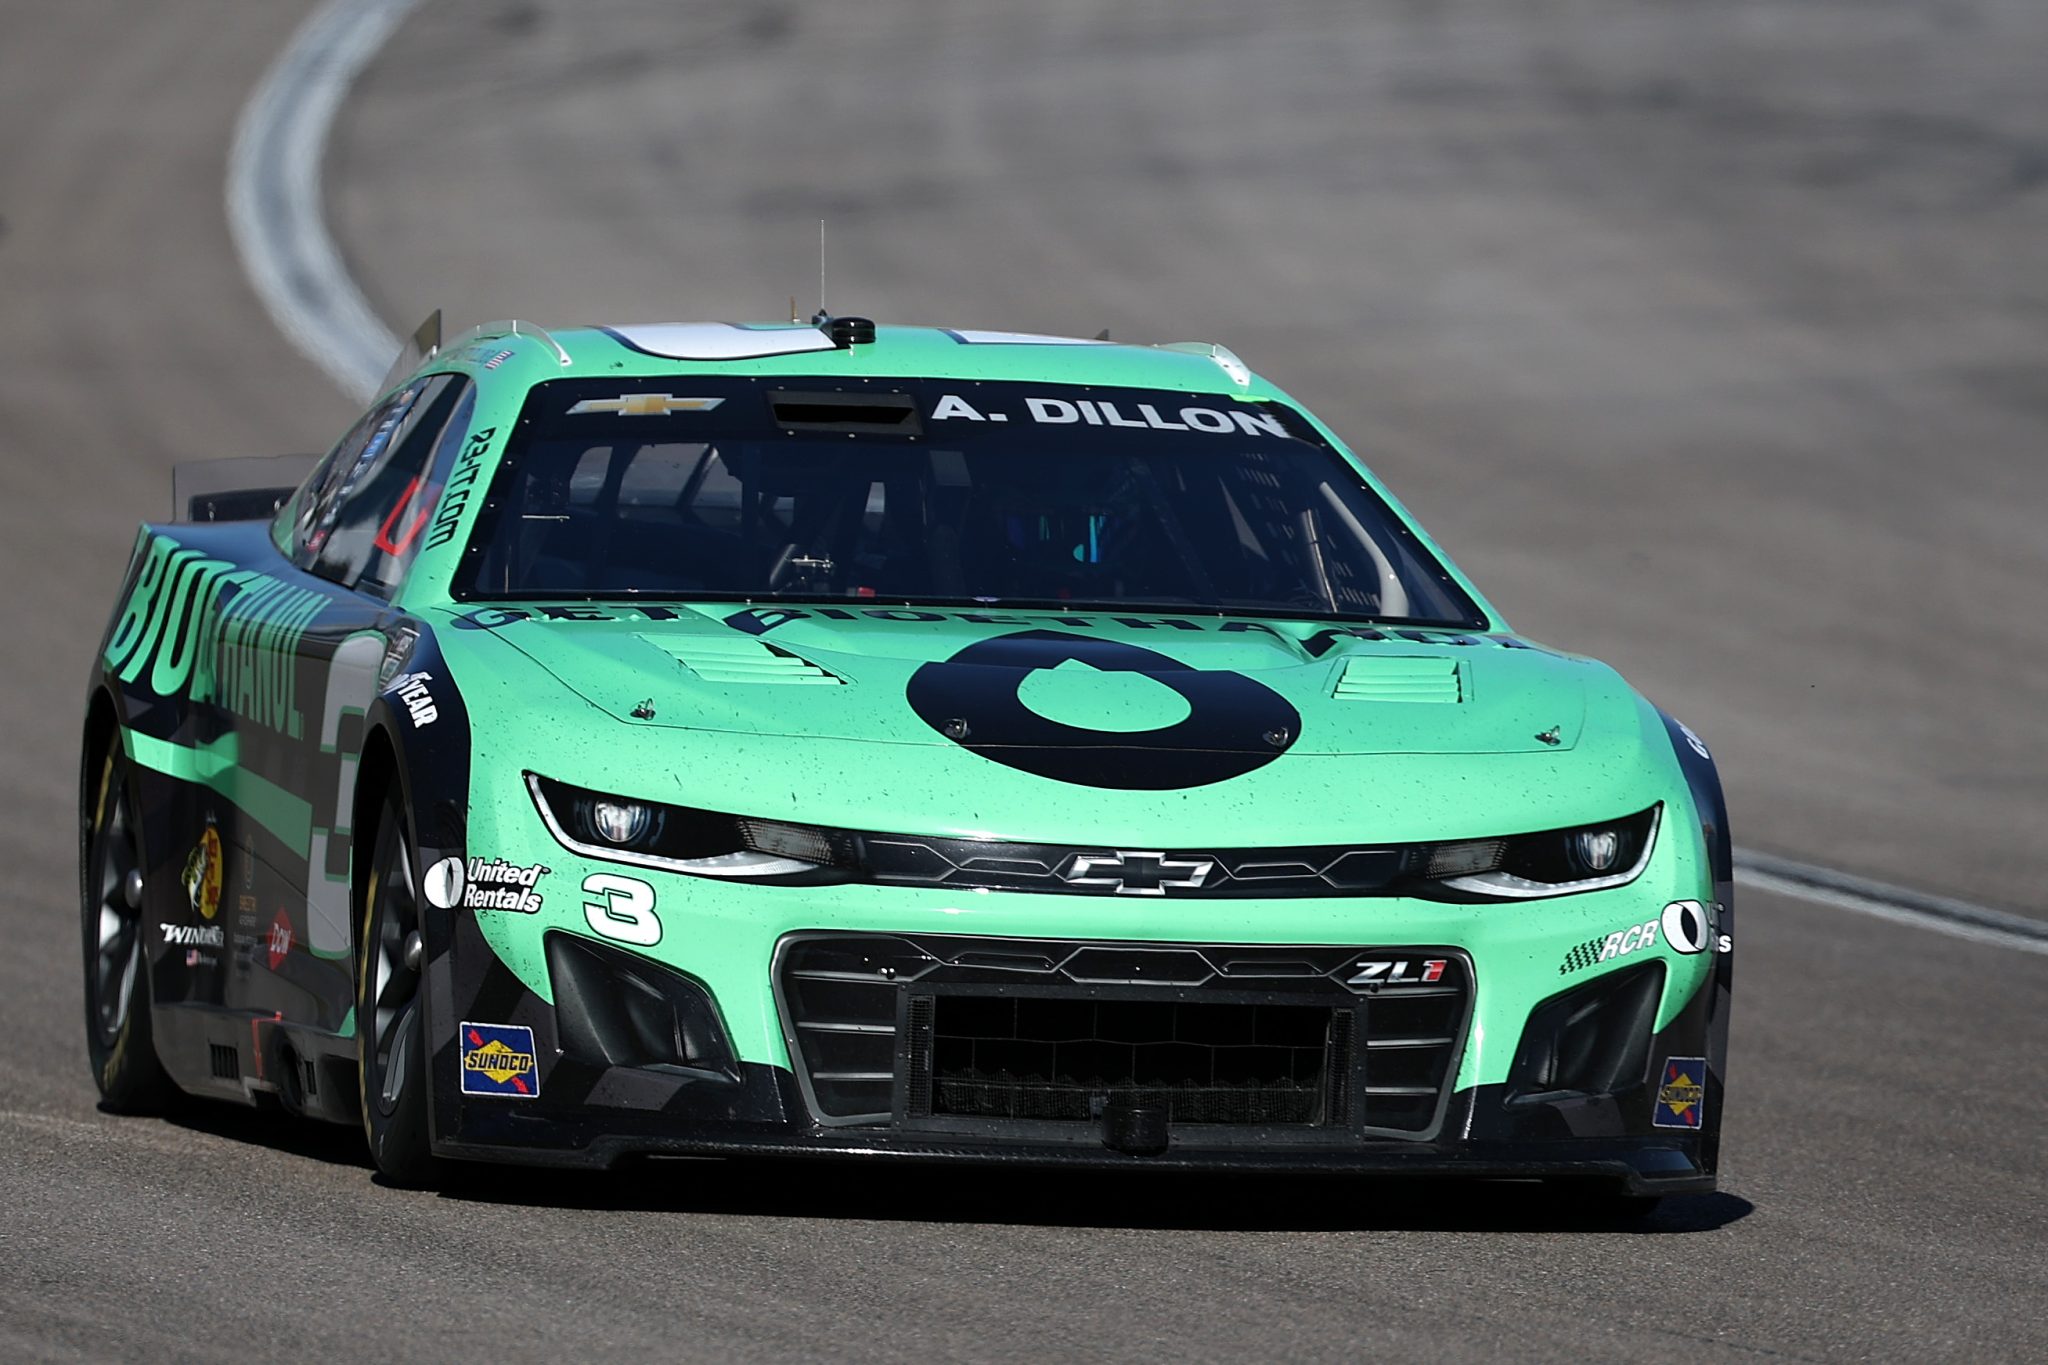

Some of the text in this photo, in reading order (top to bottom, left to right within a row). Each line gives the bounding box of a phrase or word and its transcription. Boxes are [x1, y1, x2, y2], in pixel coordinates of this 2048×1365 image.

[931, 394, 1292, 439] A. DILLON
[450, 605, 685, 630] GET
[466, 857, 543, 887] United
[463, 884, 542, 913] Rentals
[581, 873, 663, 947] 3
[1597, 918, 1660, 963] RCR
[1346, 959, 1448, 985] ZL1
[467, 1051, 531, 1072] SUNOCO
